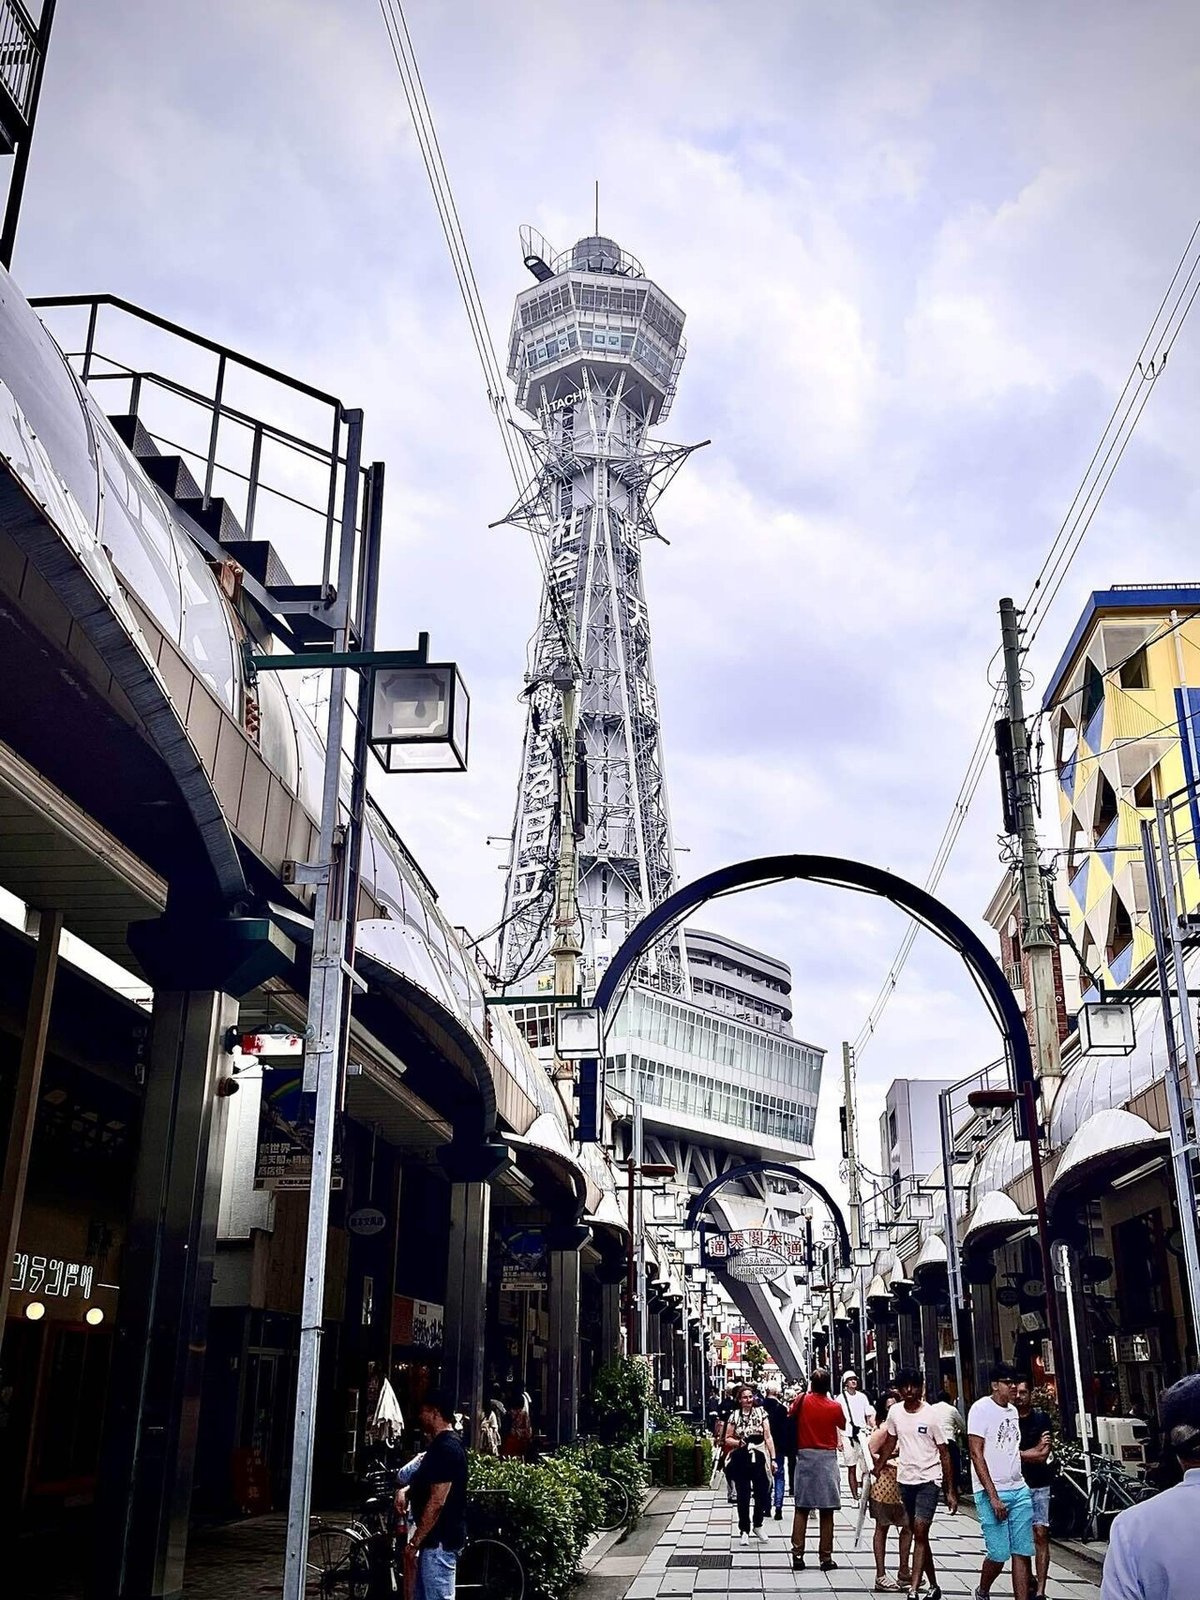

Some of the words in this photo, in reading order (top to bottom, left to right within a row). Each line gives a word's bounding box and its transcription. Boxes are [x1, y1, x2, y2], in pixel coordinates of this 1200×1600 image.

[538, 388, 588, 416] HITACHI
[710, 1230, 803, 1257] 通天閣本通
[735, 1265, 778, 1275] SHINSEKAI
[742, 1257, 772, 1265] OSAKA
